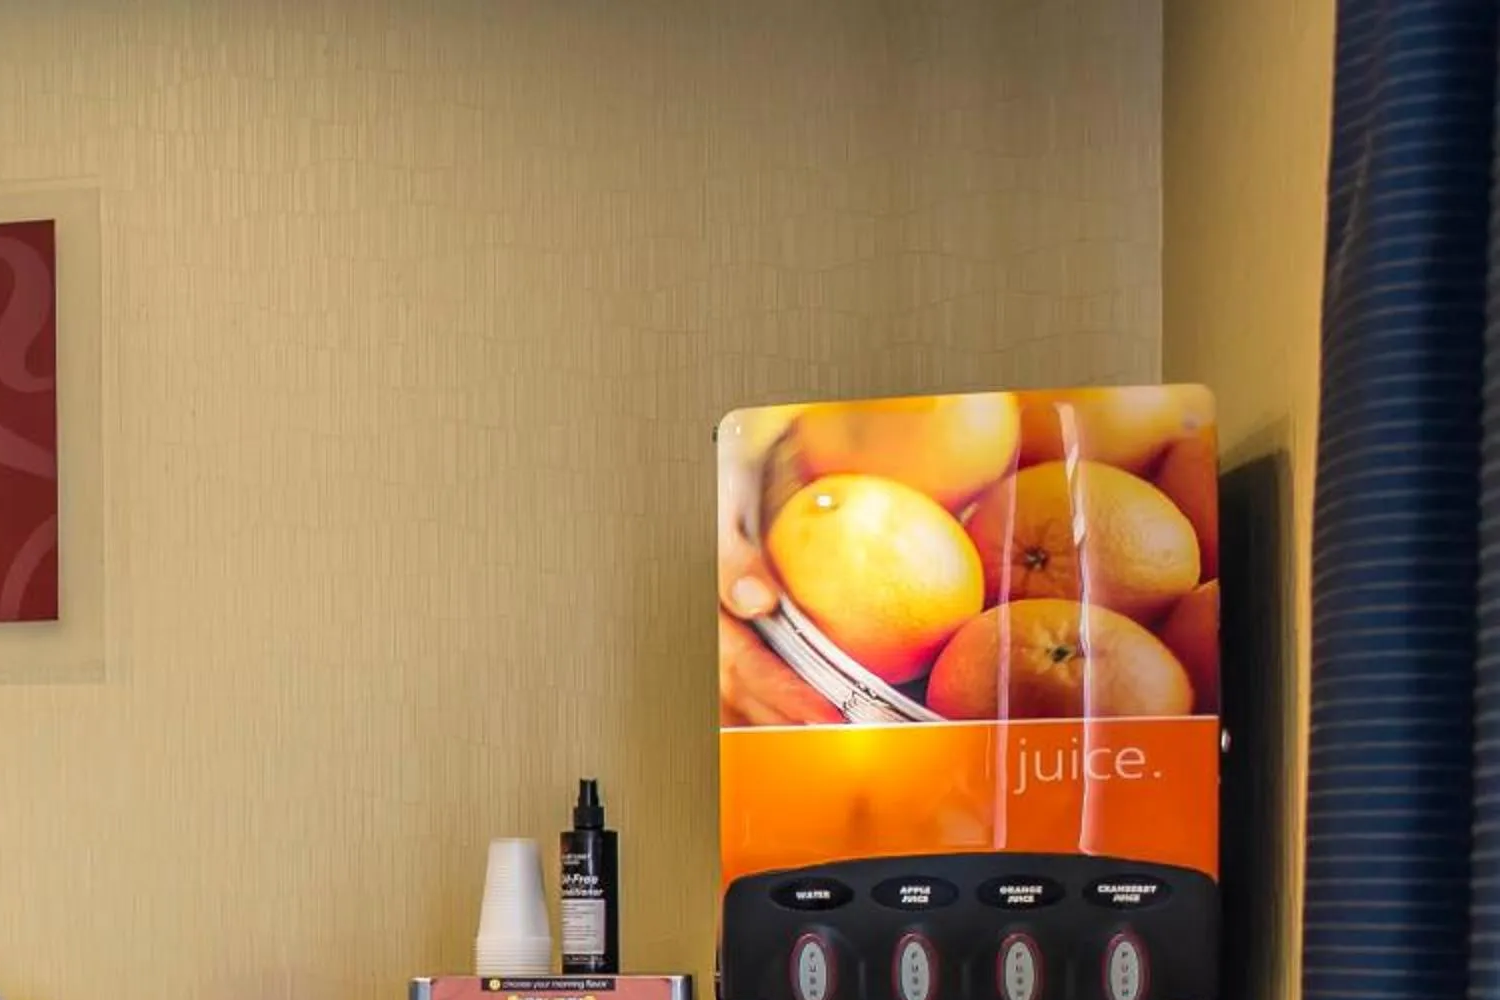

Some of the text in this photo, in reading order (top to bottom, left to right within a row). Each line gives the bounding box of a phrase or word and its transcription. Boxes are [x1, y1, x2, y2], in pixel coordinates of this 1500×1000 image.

[1013, 737, 1161, 795] juice.
[900, 885, 931, 895] APPLE
[999, 885, 1043, 895] ORANGE
[1097, 884, 1157, 894] CRANBERRY
[796, 889, 831, 900] WATER
[901, 895, 929, 903] JUICE
[1007, 895, 1035, 904] JUICE
[1112, 894, 1141, 903] JUICE
